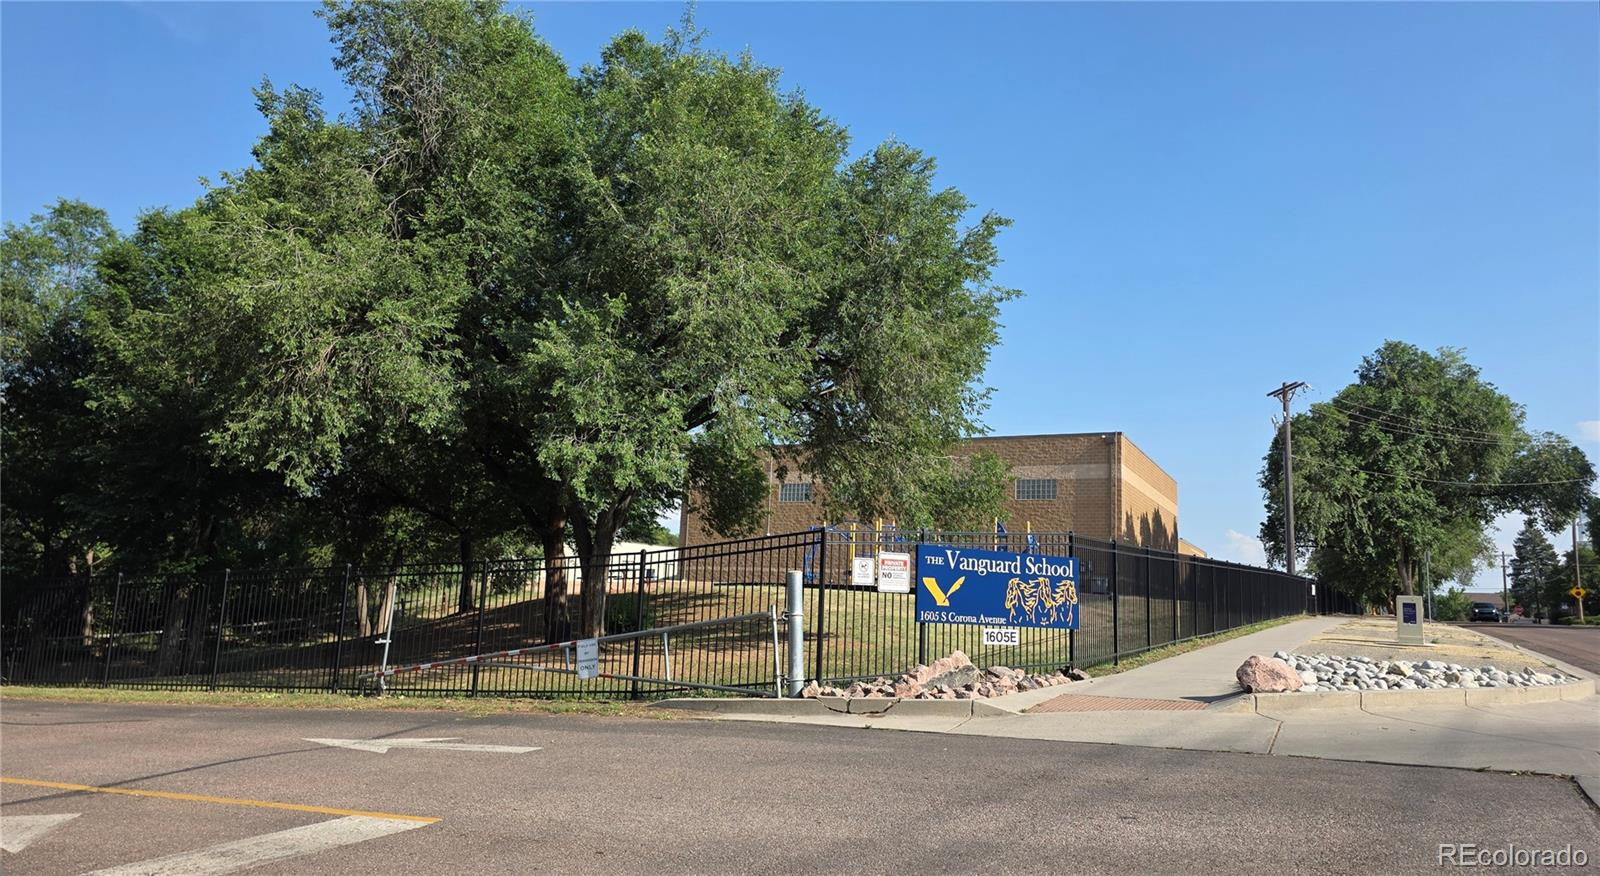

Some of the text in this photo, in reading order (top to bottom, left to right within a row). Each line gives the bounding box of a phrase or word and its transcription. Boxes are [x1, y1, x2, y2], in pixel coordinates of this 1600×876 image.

[925, 550, 1074, 578] THE Vanguard School
[920, 611, 1006, 625] 1605 S Corona Avenue
[985, 631, 1017, 643] 1605E
